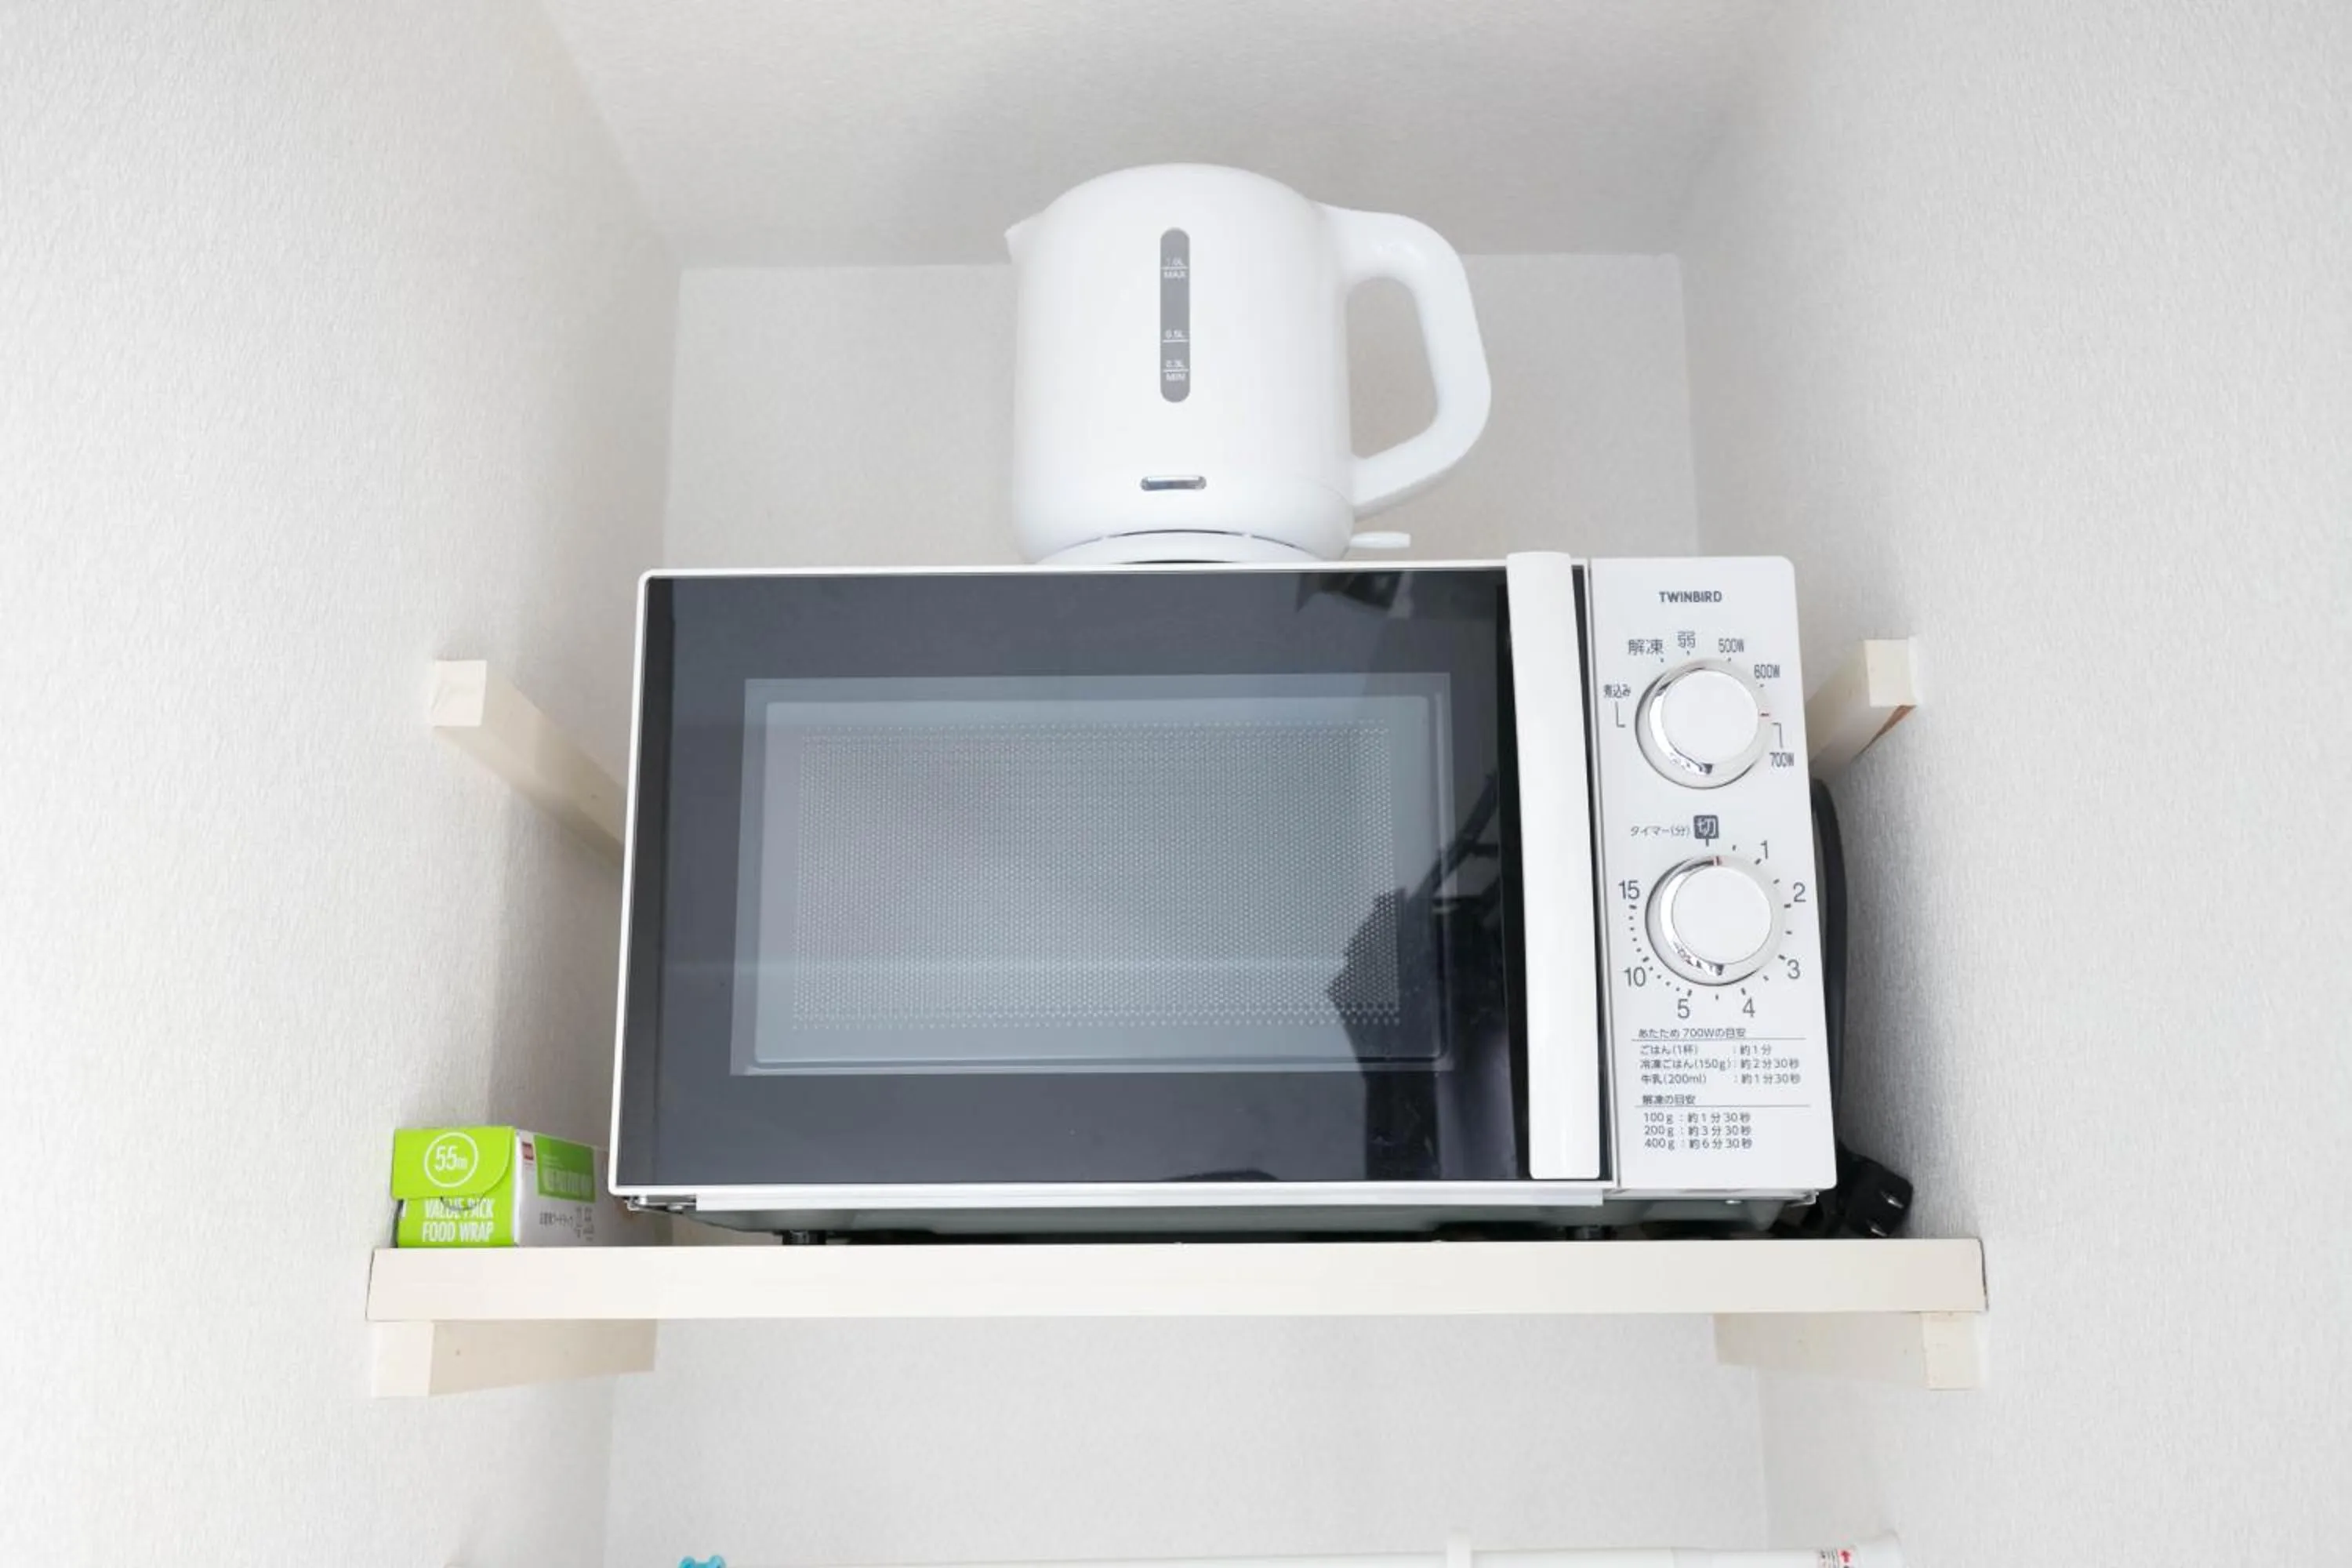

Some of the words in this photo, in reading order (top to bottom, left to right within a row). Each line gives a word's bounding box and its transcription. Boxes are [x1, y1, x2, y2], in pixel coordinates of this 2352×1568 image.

[1659, 590, 1722, 603] TWINBIRD
[1628, 639, 1664, 655] 解凍
[1678, 631, 1696, 648] 弱
[1719, 638, 1744, 652] 500W
[1754, 664, 1780, 679] 600W
[1603, 684, 1631, 698] 煮込み
[1769, 752, 1794, 768] 700W
[1695, 817, 1718, 838] 切
[1761, 840, 1768, 859] 1
[1618, 880, 1640, 900] 15
[1793, 882, 1806, 902] 2
[1624, 967, 1646, 986] 10
[1787, 959, 1800, 979] 3
[1677, 999, 1690, 1018] 5
[1742, 998, 1755, 1018] 4
[423, 1221, 455, 1243] FOOD
[460, 1221, 494, 1243] WRAP
